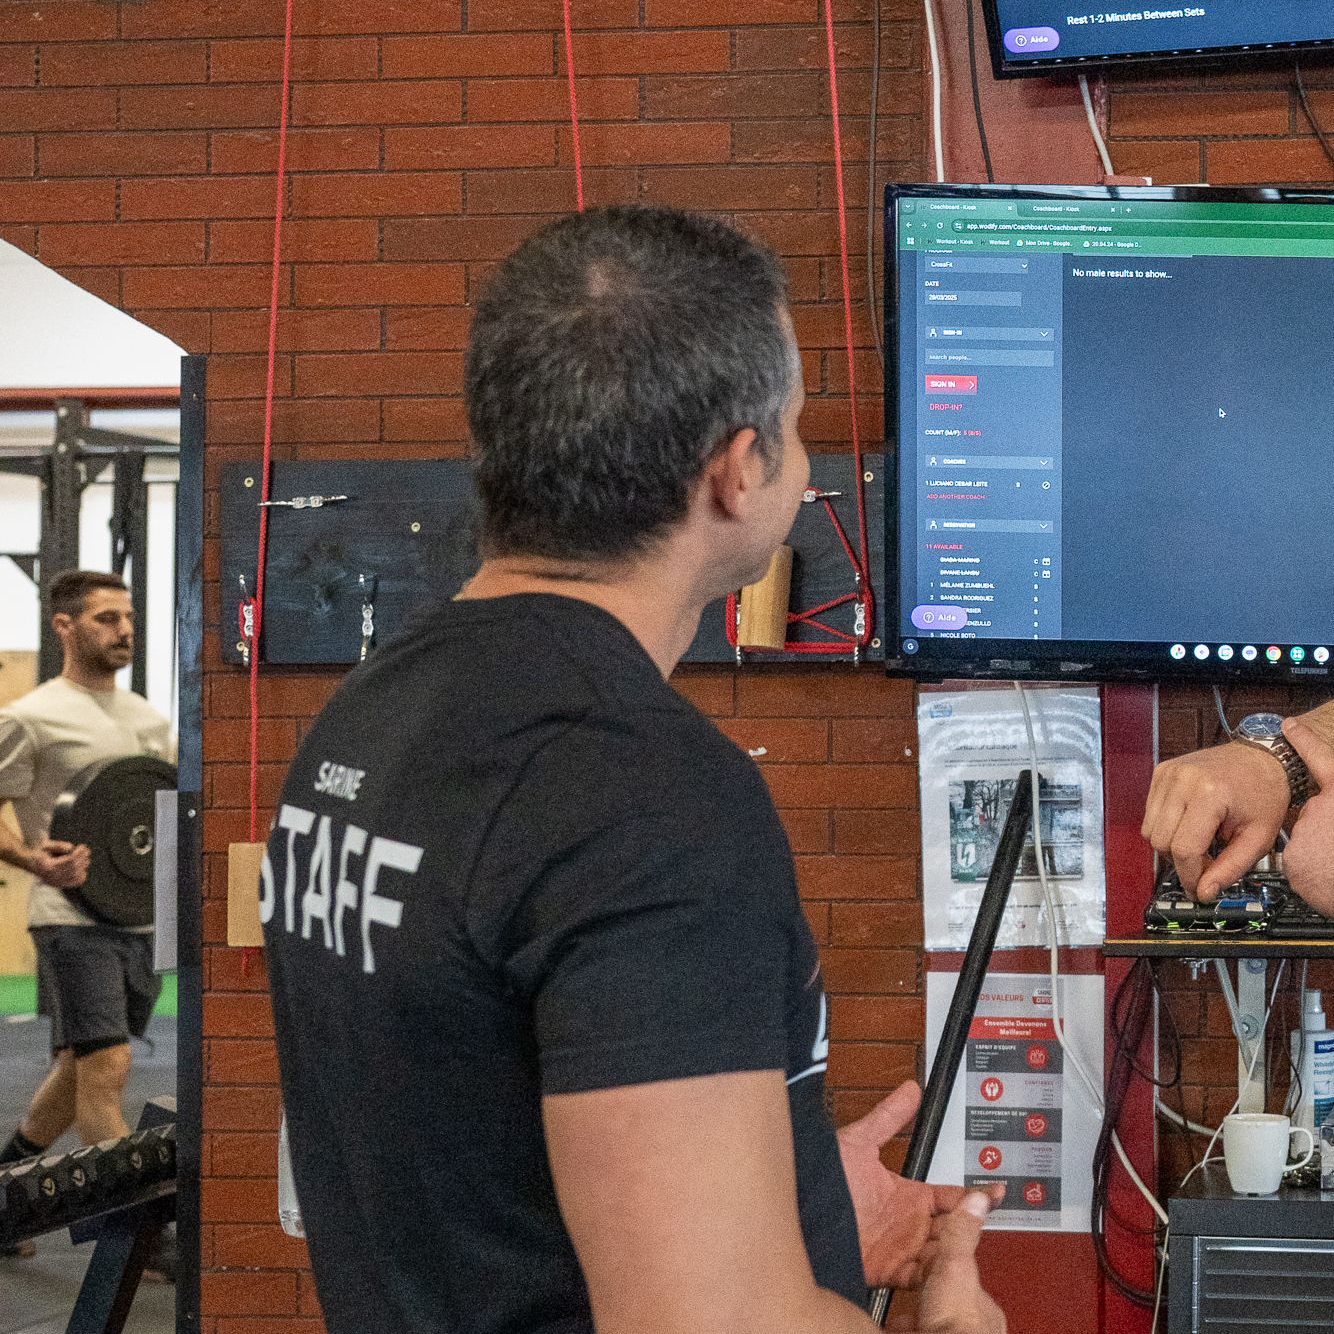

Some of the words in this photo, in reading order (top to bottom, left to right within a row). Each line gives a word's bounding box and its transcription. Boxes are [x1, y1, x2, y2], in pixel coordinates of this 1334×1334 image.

[1067, 16, 1088, 25] Rest
[1089, 14, 1104, 23] 1-2
[1105, 13, 1142, 22] Minutes
[1144, 10, 1183, 20] Between
[1184, 8, 1205, 17] Sets
[1073, 268, 1084, 277] No
[1086, 269, 1106, 277] male
[1107, 270, 1134, 278] results
[1145, 270, 1172, 278] show...
